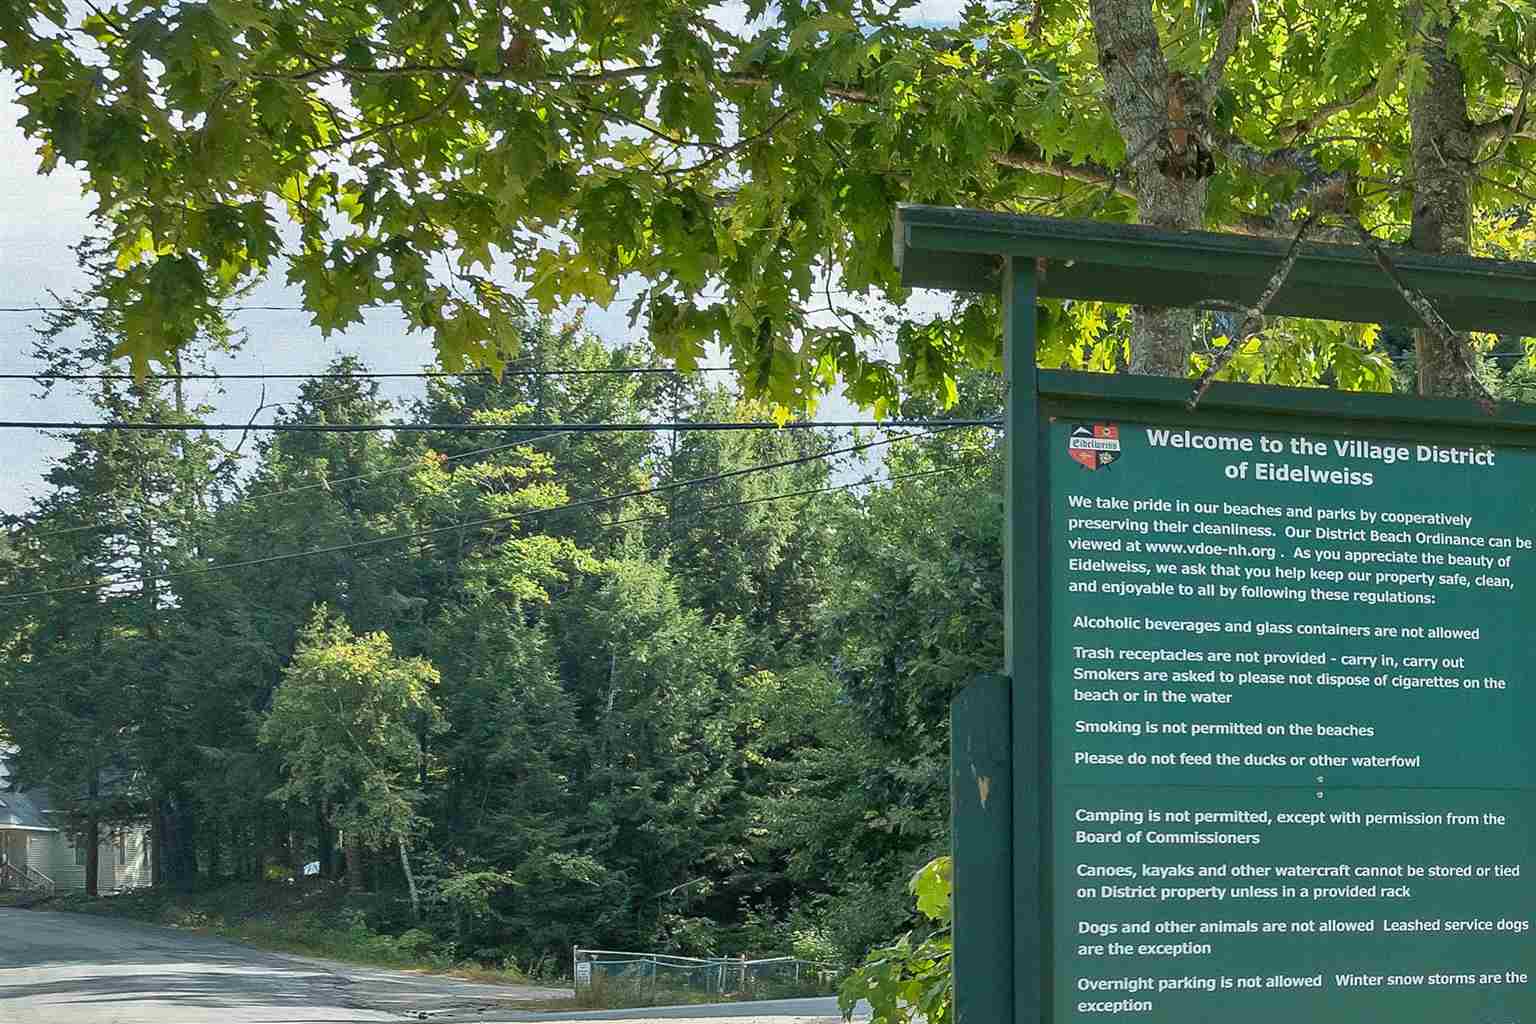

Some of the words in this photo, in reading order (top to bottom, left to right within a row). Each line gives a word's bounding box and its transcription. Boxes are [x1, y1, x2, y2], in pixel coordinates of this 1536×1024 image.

[1146, 428, 1253, 451] Welcome
[1259, 436, 1283, 453] to
[1290, 437, 1327, 456] the
[1333, 439, 1409, 463] Village
[1416, 445, 1495, 465] District
[1224, 461, 1248, 479] of
[1255, 463, 1373, 485] Eidelweiss
[1068, 495, 1092, 508] We
[1095, 496, 1128, 509] take
[1133, 498, 1171, 512] pride
[1176, 499, 1189, 512] in
[1194, 503, 1219, 513] our
[1223, 502, 1282, 516] beaches
[1286, 506, 1312, 518] and
[1316, 507, 1356, 521] parks
[1360, 509, 1377, 524] by
[1380, 512, 1472, 528] cooperatively
[1068, 518, 1148, 534] preserving
[1153, 519, 1189, 532] their
[1192, 521, 1275, 536] cleanliness.
[1284, 525, 1312, 538] Our
[1315, 527, 1366, 541] District
[1370, 529, 1411, 543] Beach
[1415, 532, 1484, 546] Ordinance
[1488, 537, 1511, 547] can
[1515, 536, 1532, 549] be
[1068, 536, 1121, 551] viewed
[1125, 540, 1141, 552] at
[1145, 542, 1275, 560] www.vdoe-nh.org
[1293, 547, 1311, 559] As
[1314, 549, 1340, 561] you
[1344, 550, 1417, 563] appreciate
[1421, 552, 1444, 564] the
[1447, 553, 1494, 568] beauty
[1497, 555, 1511, 567] of
[1069, 558, 1151, 575] Eidelweiss,
[1155, 563, 1177, 574] we
[1181, 562, 1206, 575] ask
[1210, 563, 1240, 576] that
[1244, 567, 1270, 579] you
[1275, 566, 1305, 581] help
[1310, 567, 1343, 583] keep
[1347, 571, 1372, 581] our
[1375, 572, 1435, 586] property
[1438, 573, 1470, 587] safe,
[1474, 574, 1513, 589] clean,
[1068, 580, 1096, 592] and
[1101, 581, 1174, 596] enjoyable
[1178, 583, 1193, 595] to
[1197, 583, 1214, 596] all
[1219, 584, 1237, 599] by
[1240, 585, 1306, 602] following
[1310, 587, 1349, 601] these
[1353, 590, 1435, 604] regulations:
[1072, 615, 1141, 629] Alcoholic
[1144, 617, 1221, 634] beverages
[1224, 620, 1251, 632] and
[1255, 621, 1293, 635] glass
[1296, 623, 1370, 636] containers
[1374, 627, 1397, 637] are
[1401, 626, 1424, 638] not
[1427, 626, 1479, 640] allowed
[1075, 720, 1141, 735] Smoking
[1145, 721, 1158, 733] is
[1162, 722, 1187, 733] not
[1191, 722, 1262, 736] permitted
[1266, 725, 1285, 735] on
[1288, 723, 1313, 735] the
[1317, 723, 1374, 736] beaches
[1074, 751, 1124, 764] Please
[1127, 752, 1146, 764] do
[1151, 753, 1176, 764] not
[1179, 752, 1211, 765] feed
[1215, 752, 1240, 765] the
[1244, 753, 1286, 766] ducks
[1290, 756, 1306, 766] or
[1309, 754, 1348, 766] other
[1351, 755, 1420, 767] waterfowl
[1075, 808, 1143, 824] Camping
[1148, 809, 1160, 821] is
[1165, 810, 1191, 822] not
[1194, 810, 1272, 825] permitted,
[1276, 811, 1326, 826] except
[1329, 811, 1360, 823] with
[1365, 811, 1442, 826] permission
[1446, 812, 1479, 824] from
[1483, 813, 1505, 825] the
[1075, 830, 1121, 843] Board
[1126, 830, 1142, 843] of
[1145, 831, 1260, 844] Commissioners
[1078, 921, 1118, 936] Dogs
[1121, 920, 1150, 933] and
[1155, 920, 1196, 933] other
[1199, 919, 1258, 932] animals
[1262, 922, 1287, 932] are
[1291, 920, 1315, 932] not
[1319, 919, 1374, 931] allowed
[1383, 919, 1440, 931] Leashed
[1444, 918, 1492, 931] service
[1496, 918, 1528, 932] dogs
[1077, 945, 1104, 955] are
[1108, 942, 1133, 955] the
[1137, 941, 1211, 957] exception
